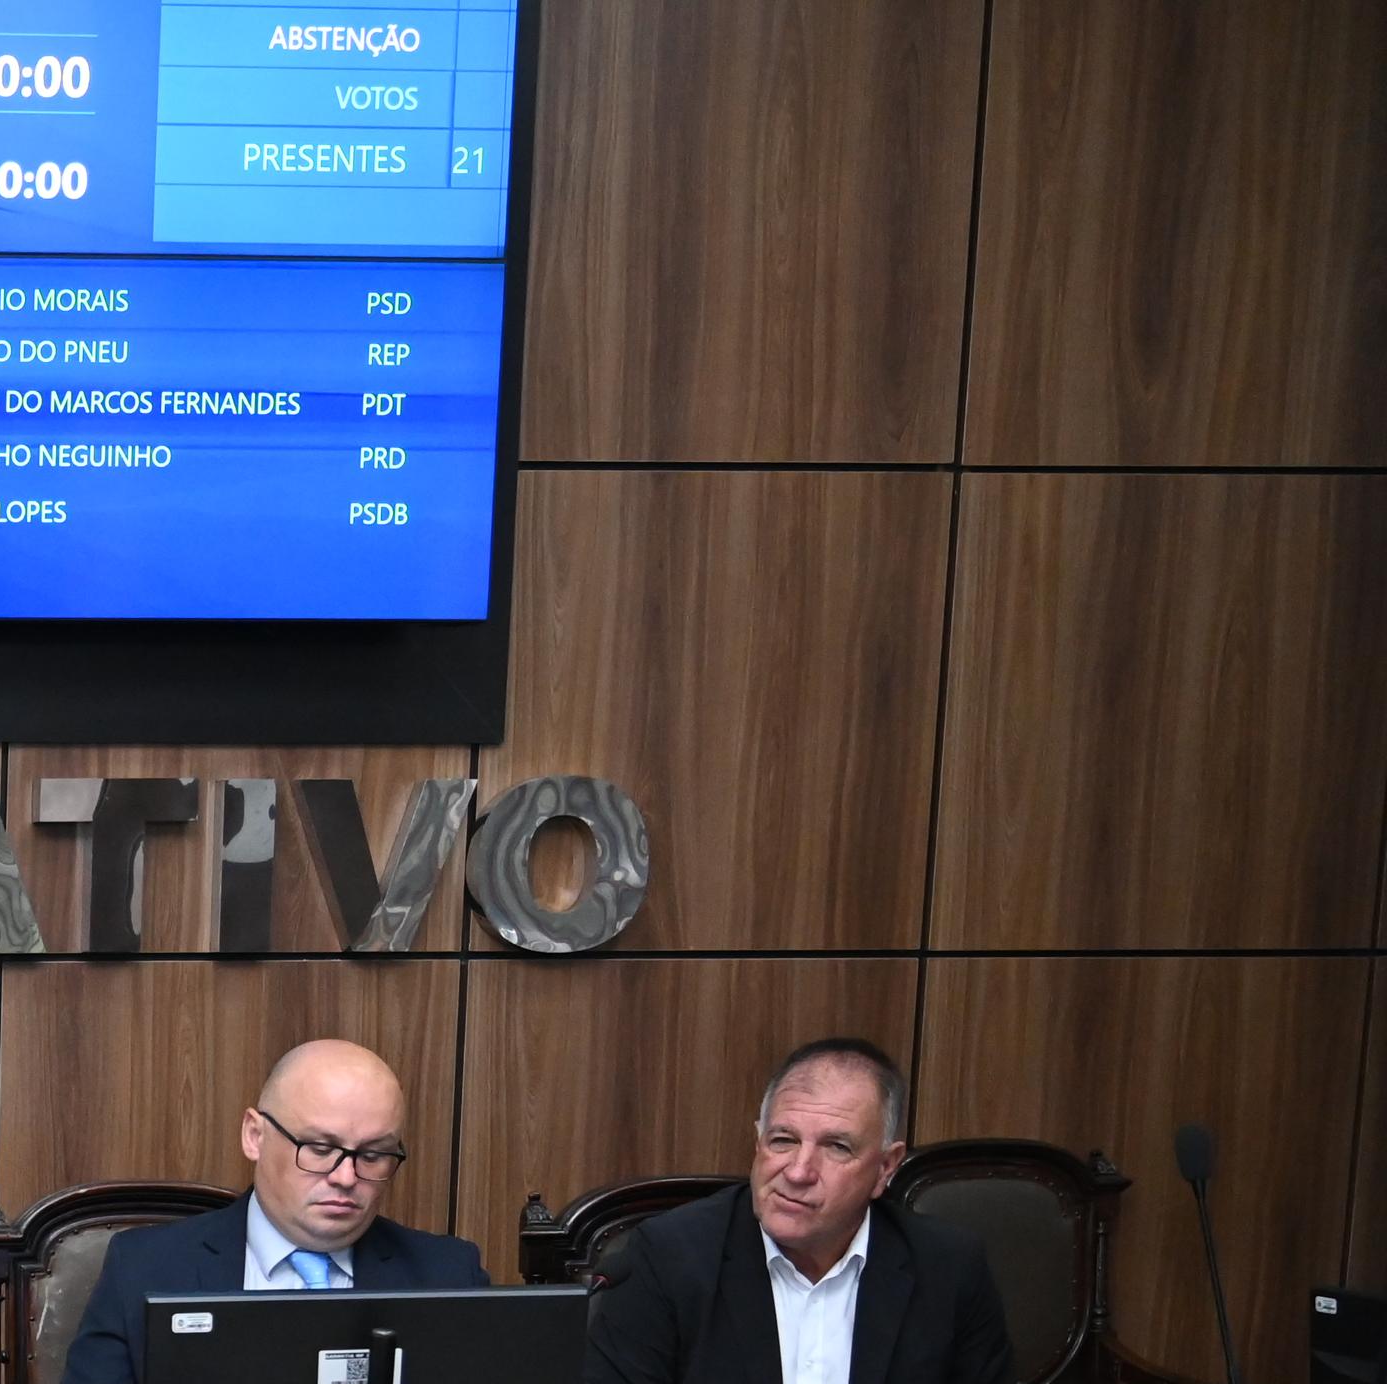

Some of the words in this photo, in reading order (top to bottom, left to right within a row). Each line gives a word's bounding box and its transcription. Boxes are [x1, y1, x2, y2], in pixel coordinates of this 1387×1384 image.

[267, 22, 422, 59] ABSTENÇÃO
[334, 84, 420, 112] VOTOS
[242, 142, 407, 175] PRESENTES
[451, 145, 484, 175] 21
[32, 287, 130, 313] MORAIS
[366, 291, 413, 316] PSD
[18, 338, 58, 364] DO
[63, 339, 129, 365] PNEU
[367, 342, 412, 367] REP
[4, 388, 44, 414] DO
[49, 389, 154, 415] MARCOS
[159, 390, 302, 417] FERNANDES
[361, 391, 408, 417] PDT
[37, 443, 173, 469] NEGUINHO
[358, 445, 407, 471] PRD
[348, 501, 409, 526] PSDB
